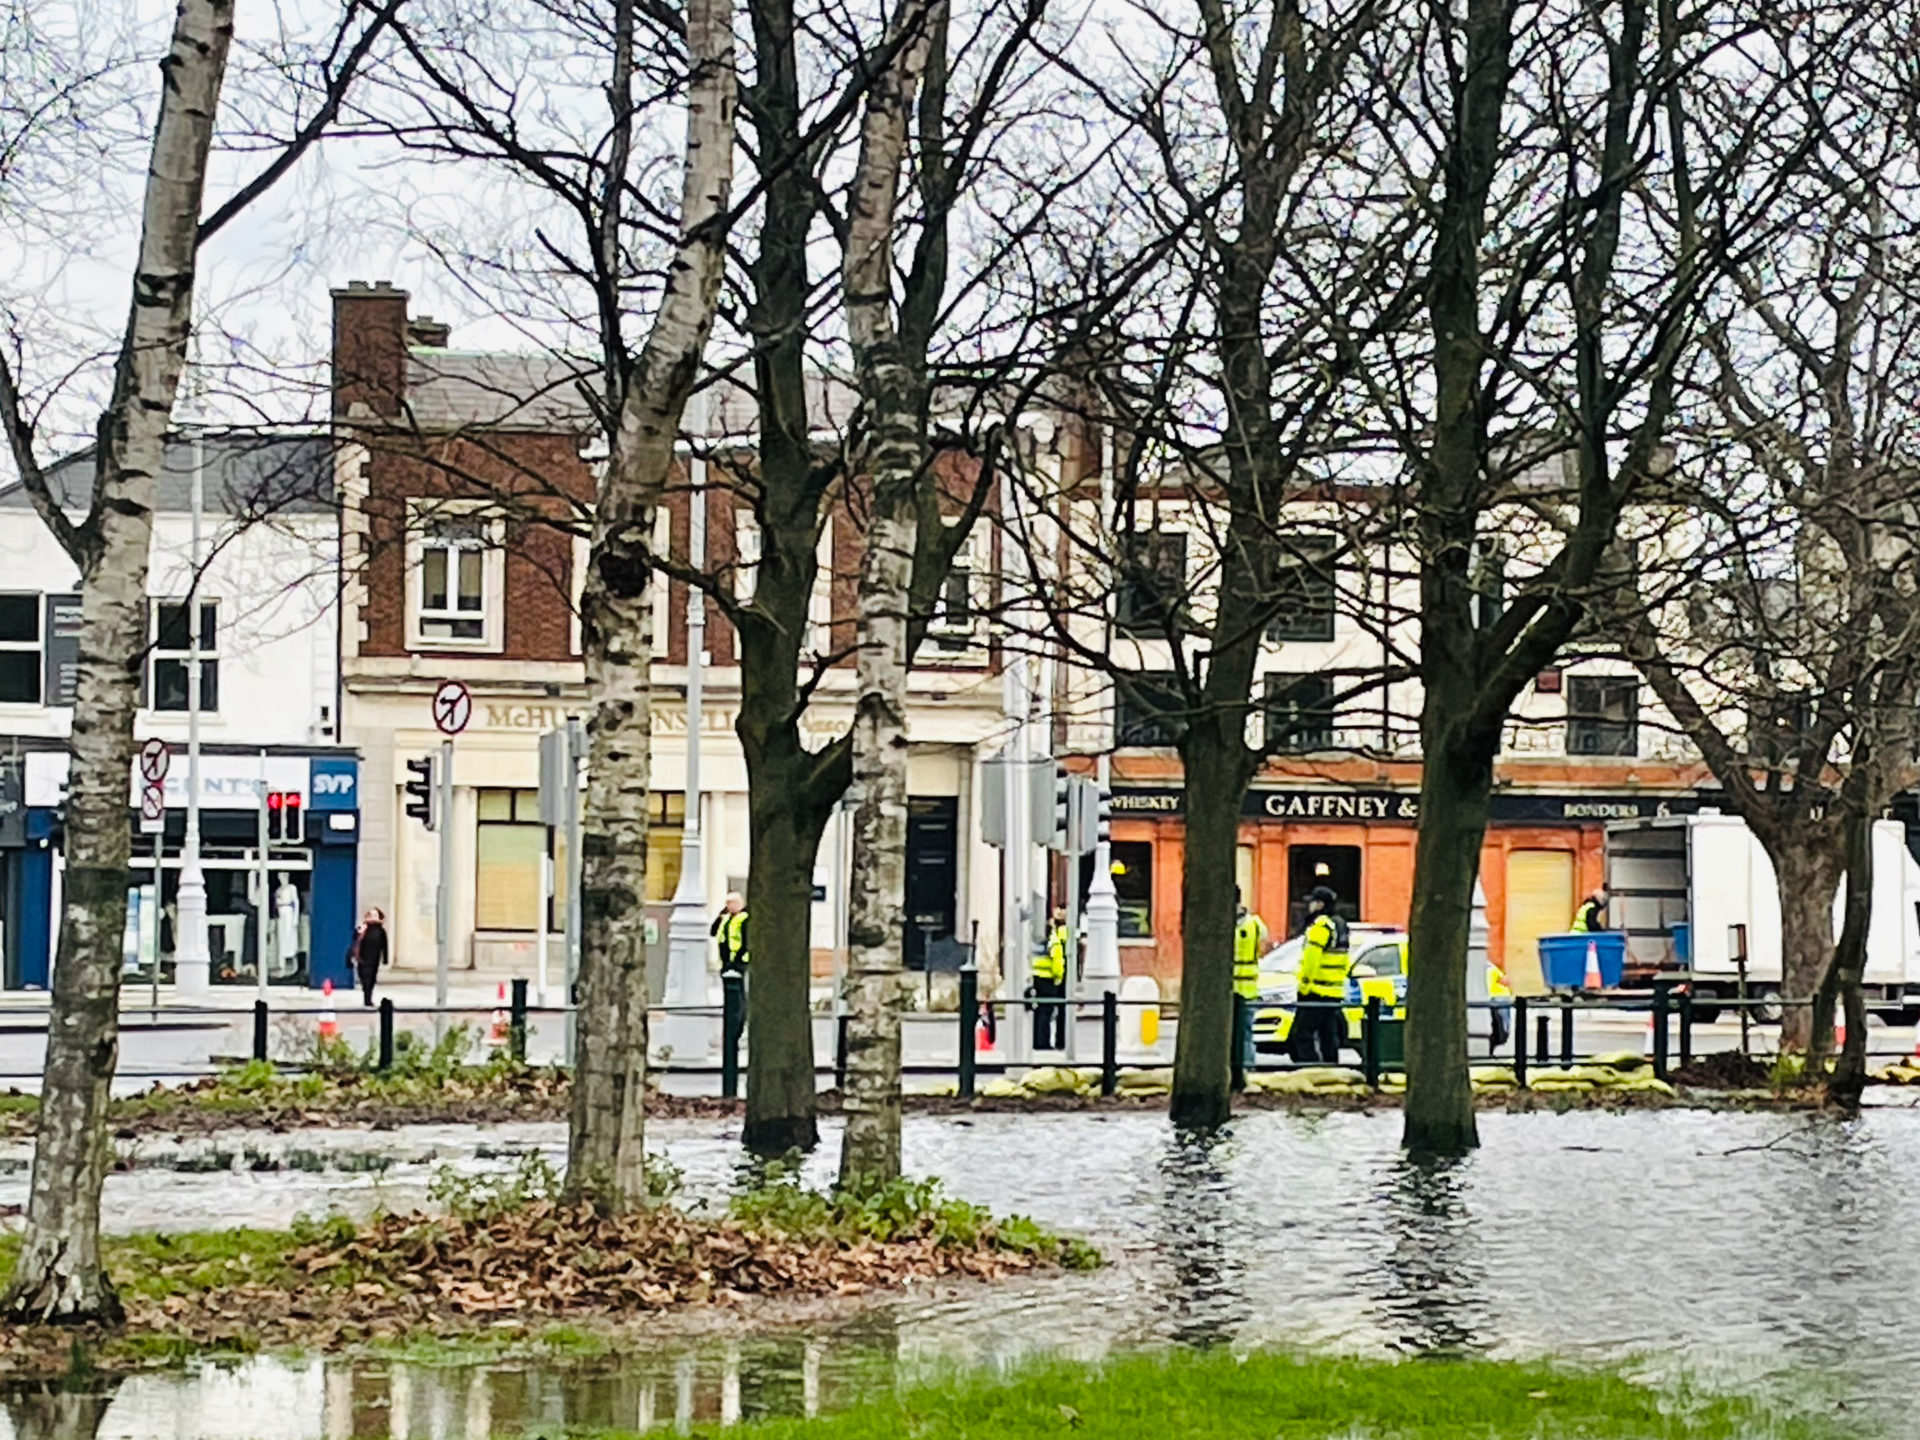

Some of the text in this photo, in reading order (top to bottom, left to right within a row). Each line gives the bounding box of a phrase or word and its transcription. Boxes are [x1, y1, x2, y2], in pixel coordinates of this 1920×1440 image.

[313, 773, 355, 794] SVP
[1265, 794, 1419, 818] GAFFNEY &
